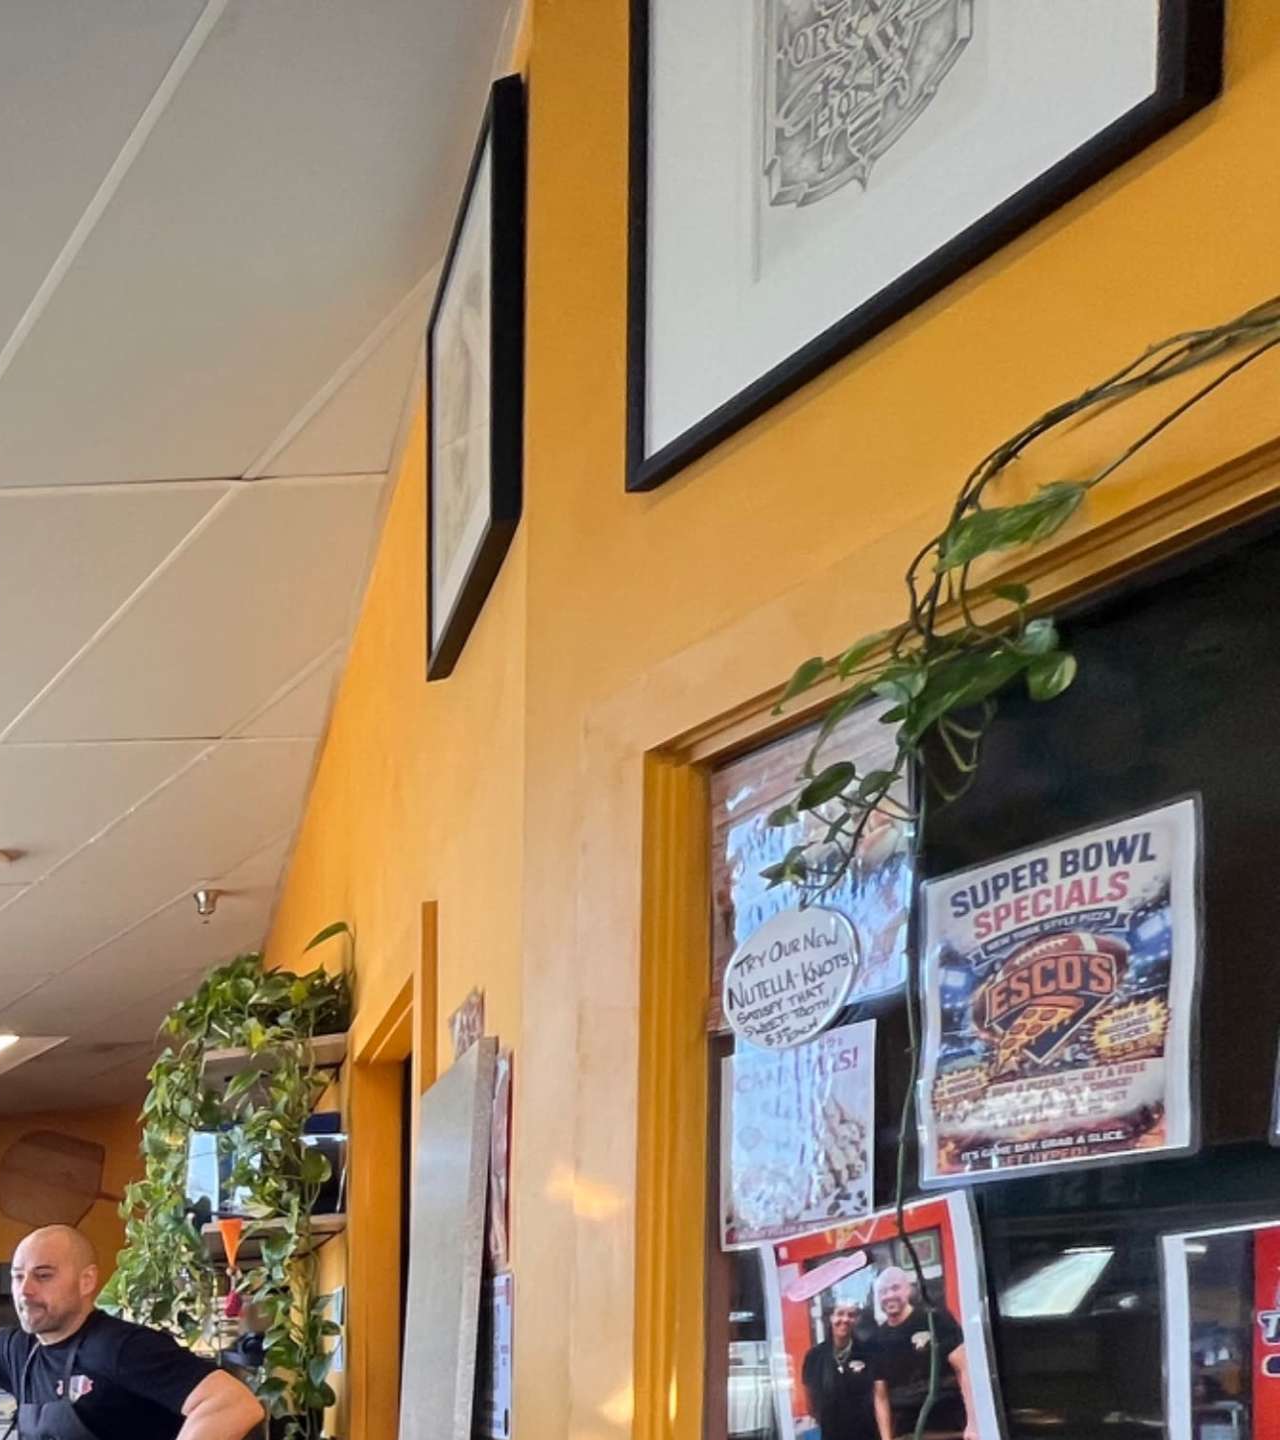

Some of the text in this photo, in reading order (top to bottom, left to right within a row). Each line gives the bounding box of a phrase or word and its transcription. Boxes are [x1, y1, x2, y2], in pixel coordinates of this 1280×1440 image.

[950, 832, 1156, 918] SUPER BOWL
[972, 870, 1130, 940] SPECIALS
[1043, 916, 1076, 931] STYLE
[1078, 910, 1111, 924] PIZZA
[735, 926, 839, 977] TRY OUR NEW
[789, 982, 825, 1007] THAT
